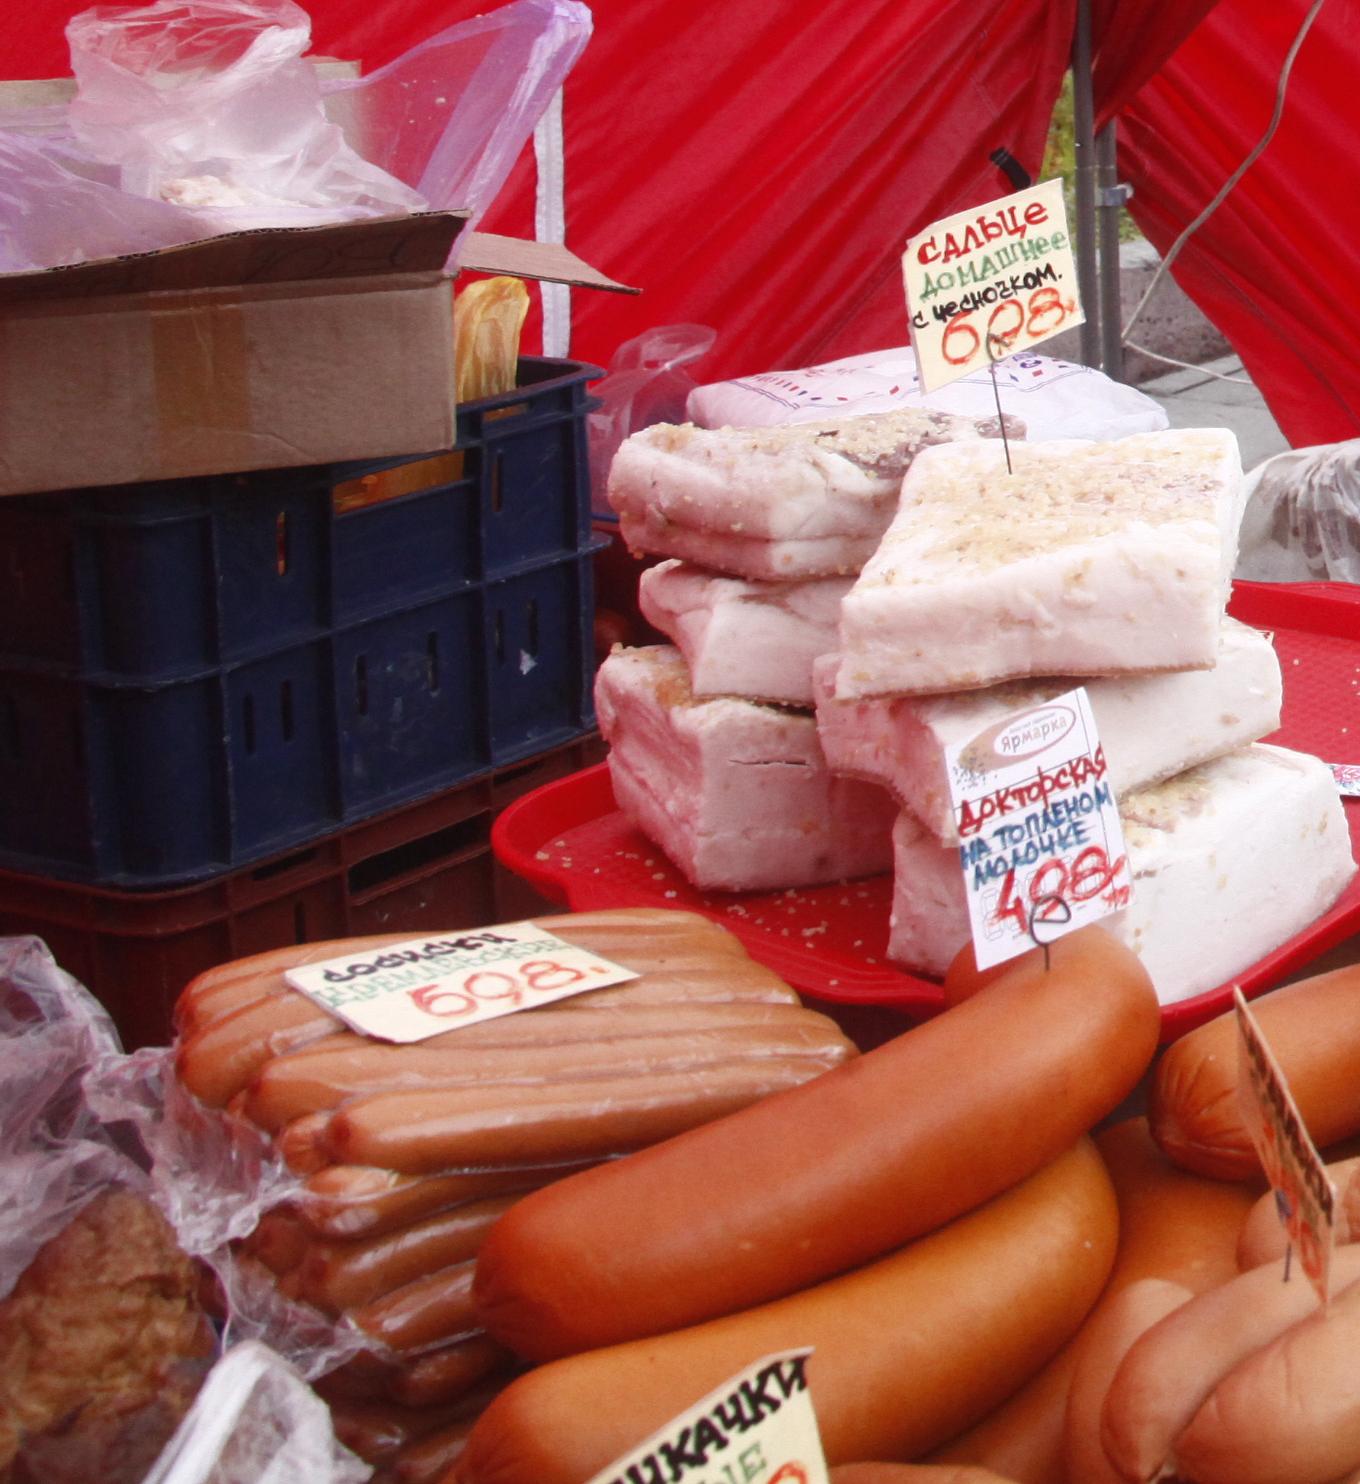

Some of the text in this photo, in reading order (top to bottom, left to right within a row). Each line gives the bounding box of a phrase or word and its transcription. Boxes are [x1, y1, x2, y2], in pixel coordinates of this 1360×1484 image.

[1000, 715, 1067, 753] Ярмарка
[958, 742, 1107, 837] ДОКТОРСКАЯ
[960, 838, 992, 870] НА
[974, 820, 1091, 891] МОЛОЧКЕ
